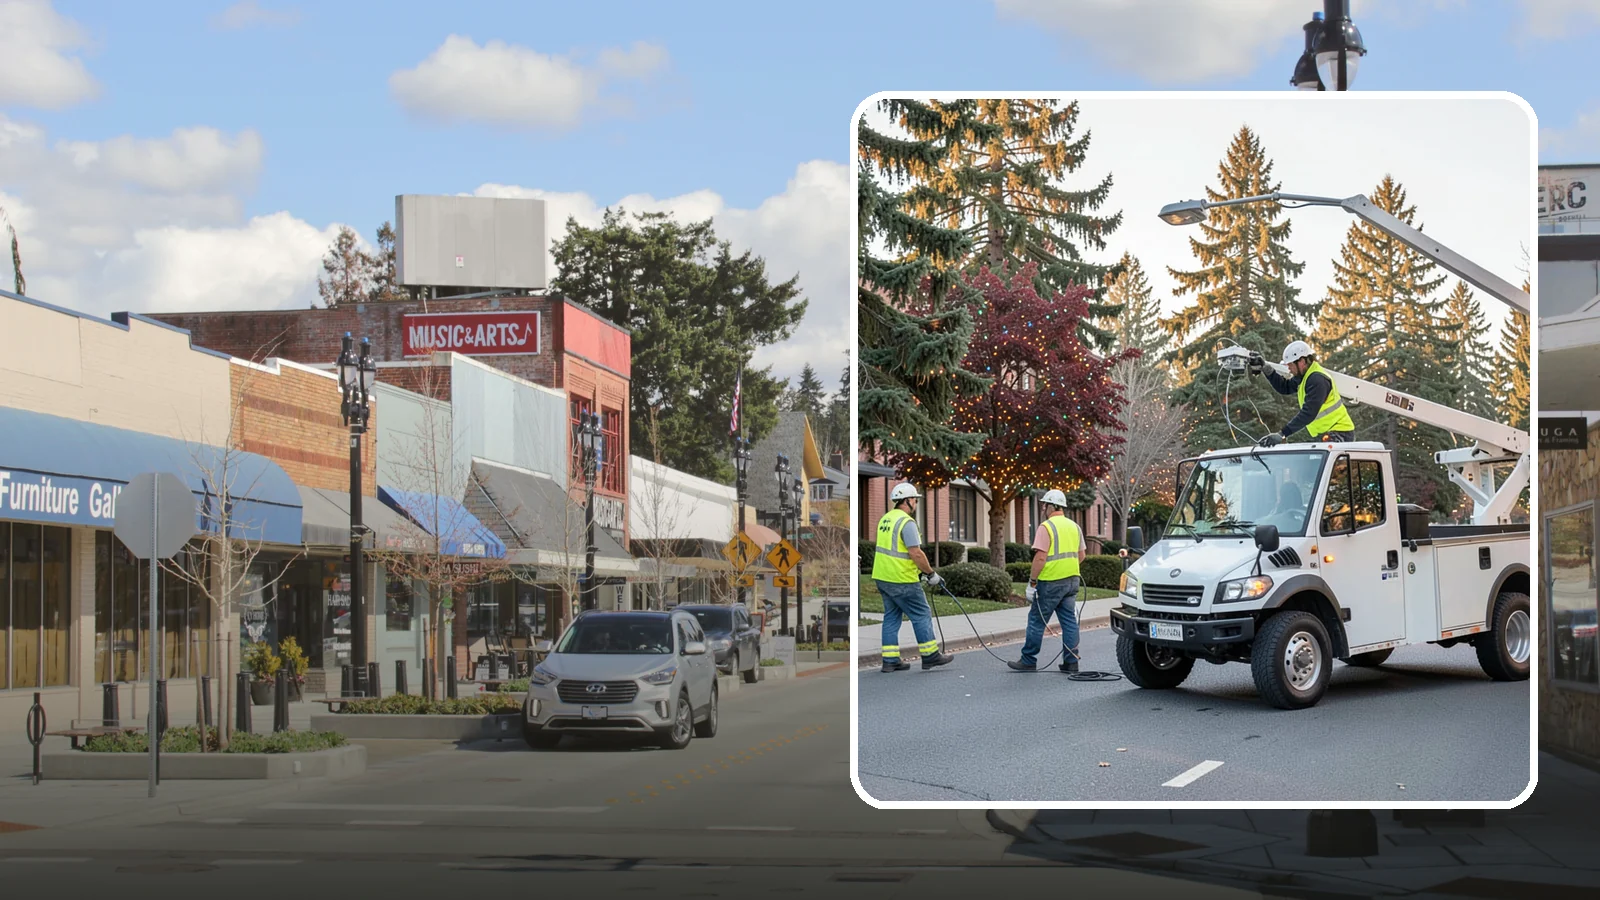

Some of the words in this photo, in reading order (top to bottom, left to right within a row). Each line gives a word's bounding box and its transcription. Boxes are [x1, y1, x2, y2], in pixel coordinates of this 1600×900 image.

[409, 323, 519, 349] MUSIC&ARTS
[0, 471, 79, 515] Furniture
[89, 482, 121, 519] Gal
[453, 563, 479, 574] SUSHI
